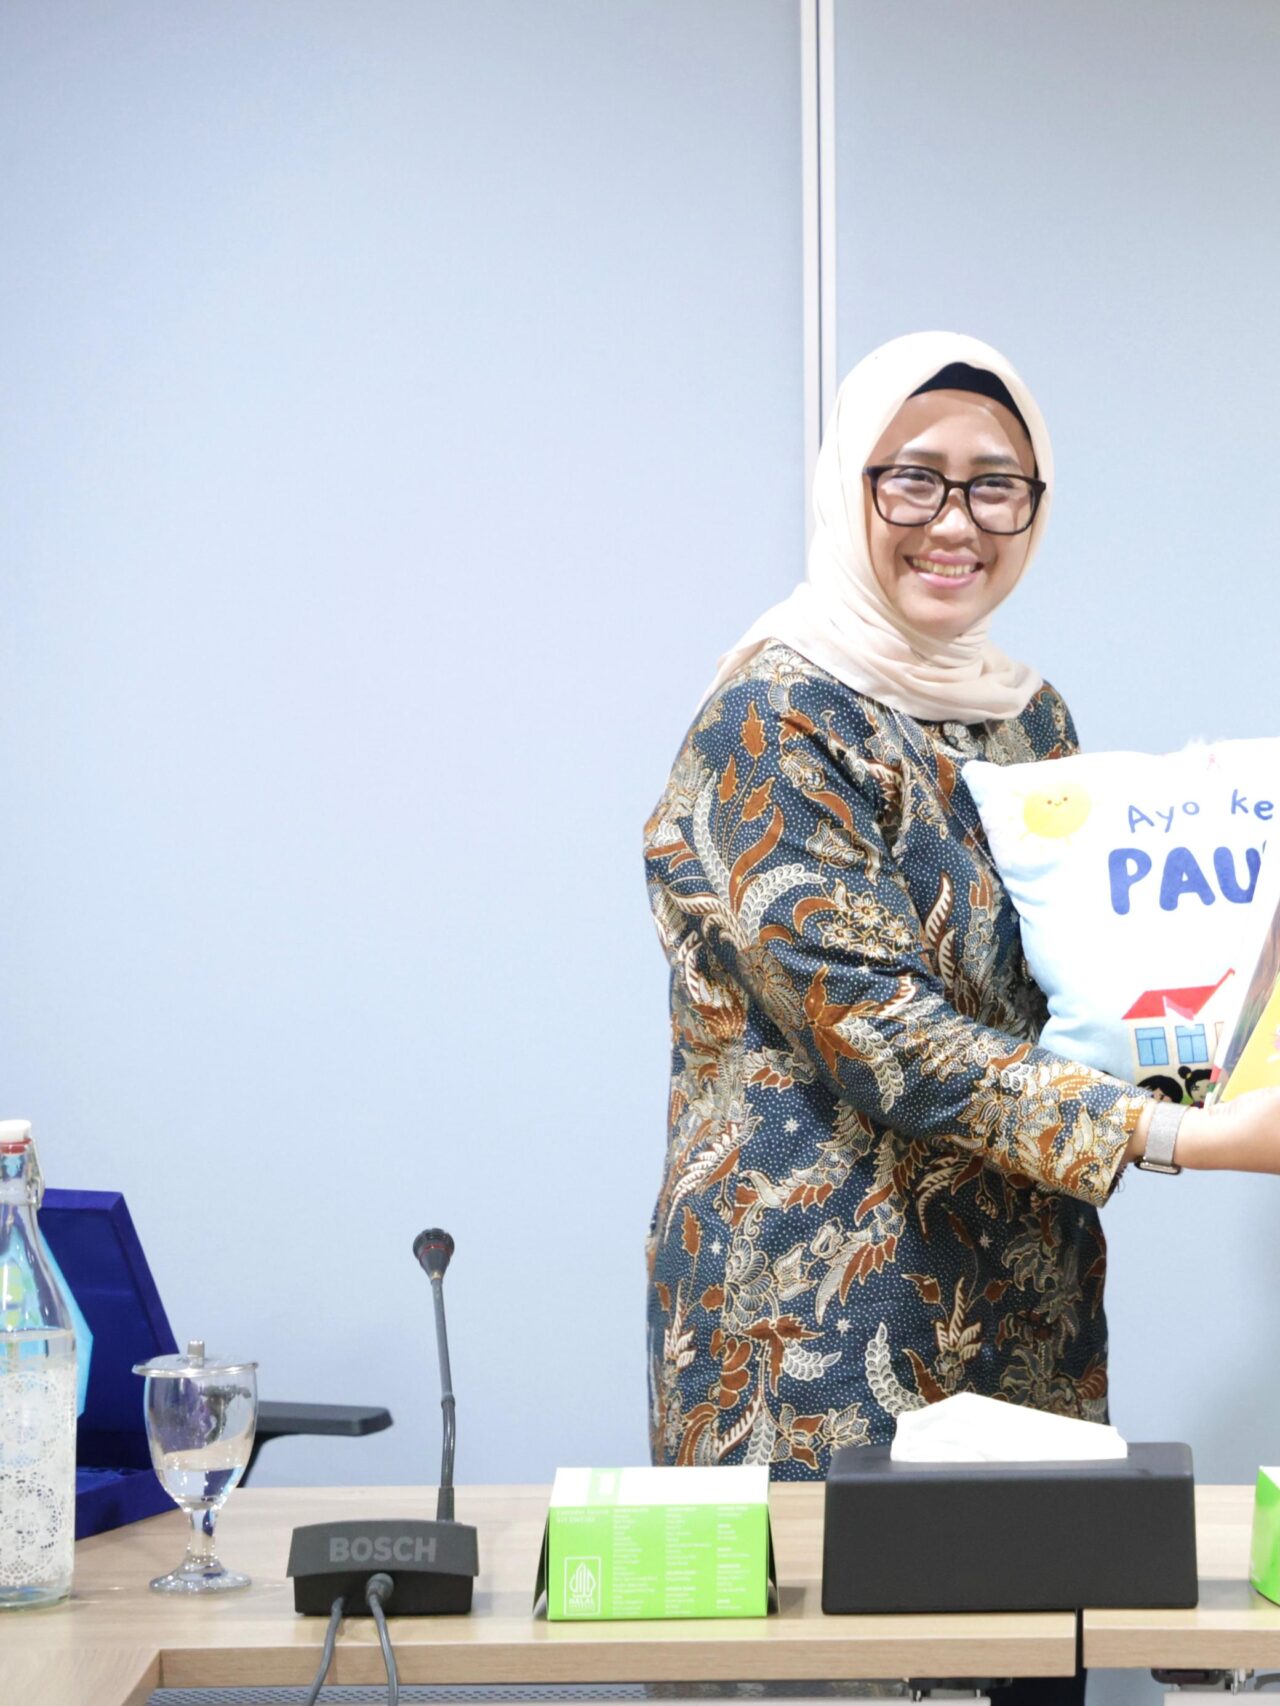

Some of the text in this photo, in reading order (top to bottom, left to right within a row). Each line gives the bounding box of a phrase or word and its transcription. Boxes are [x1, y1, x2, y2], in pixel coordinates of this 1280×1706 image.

[1128, 789, 1274, 833] Ayo ke
[1108, 840, 1266, 915] PAU
[329, 1536, 437, 1562] BOSCH
